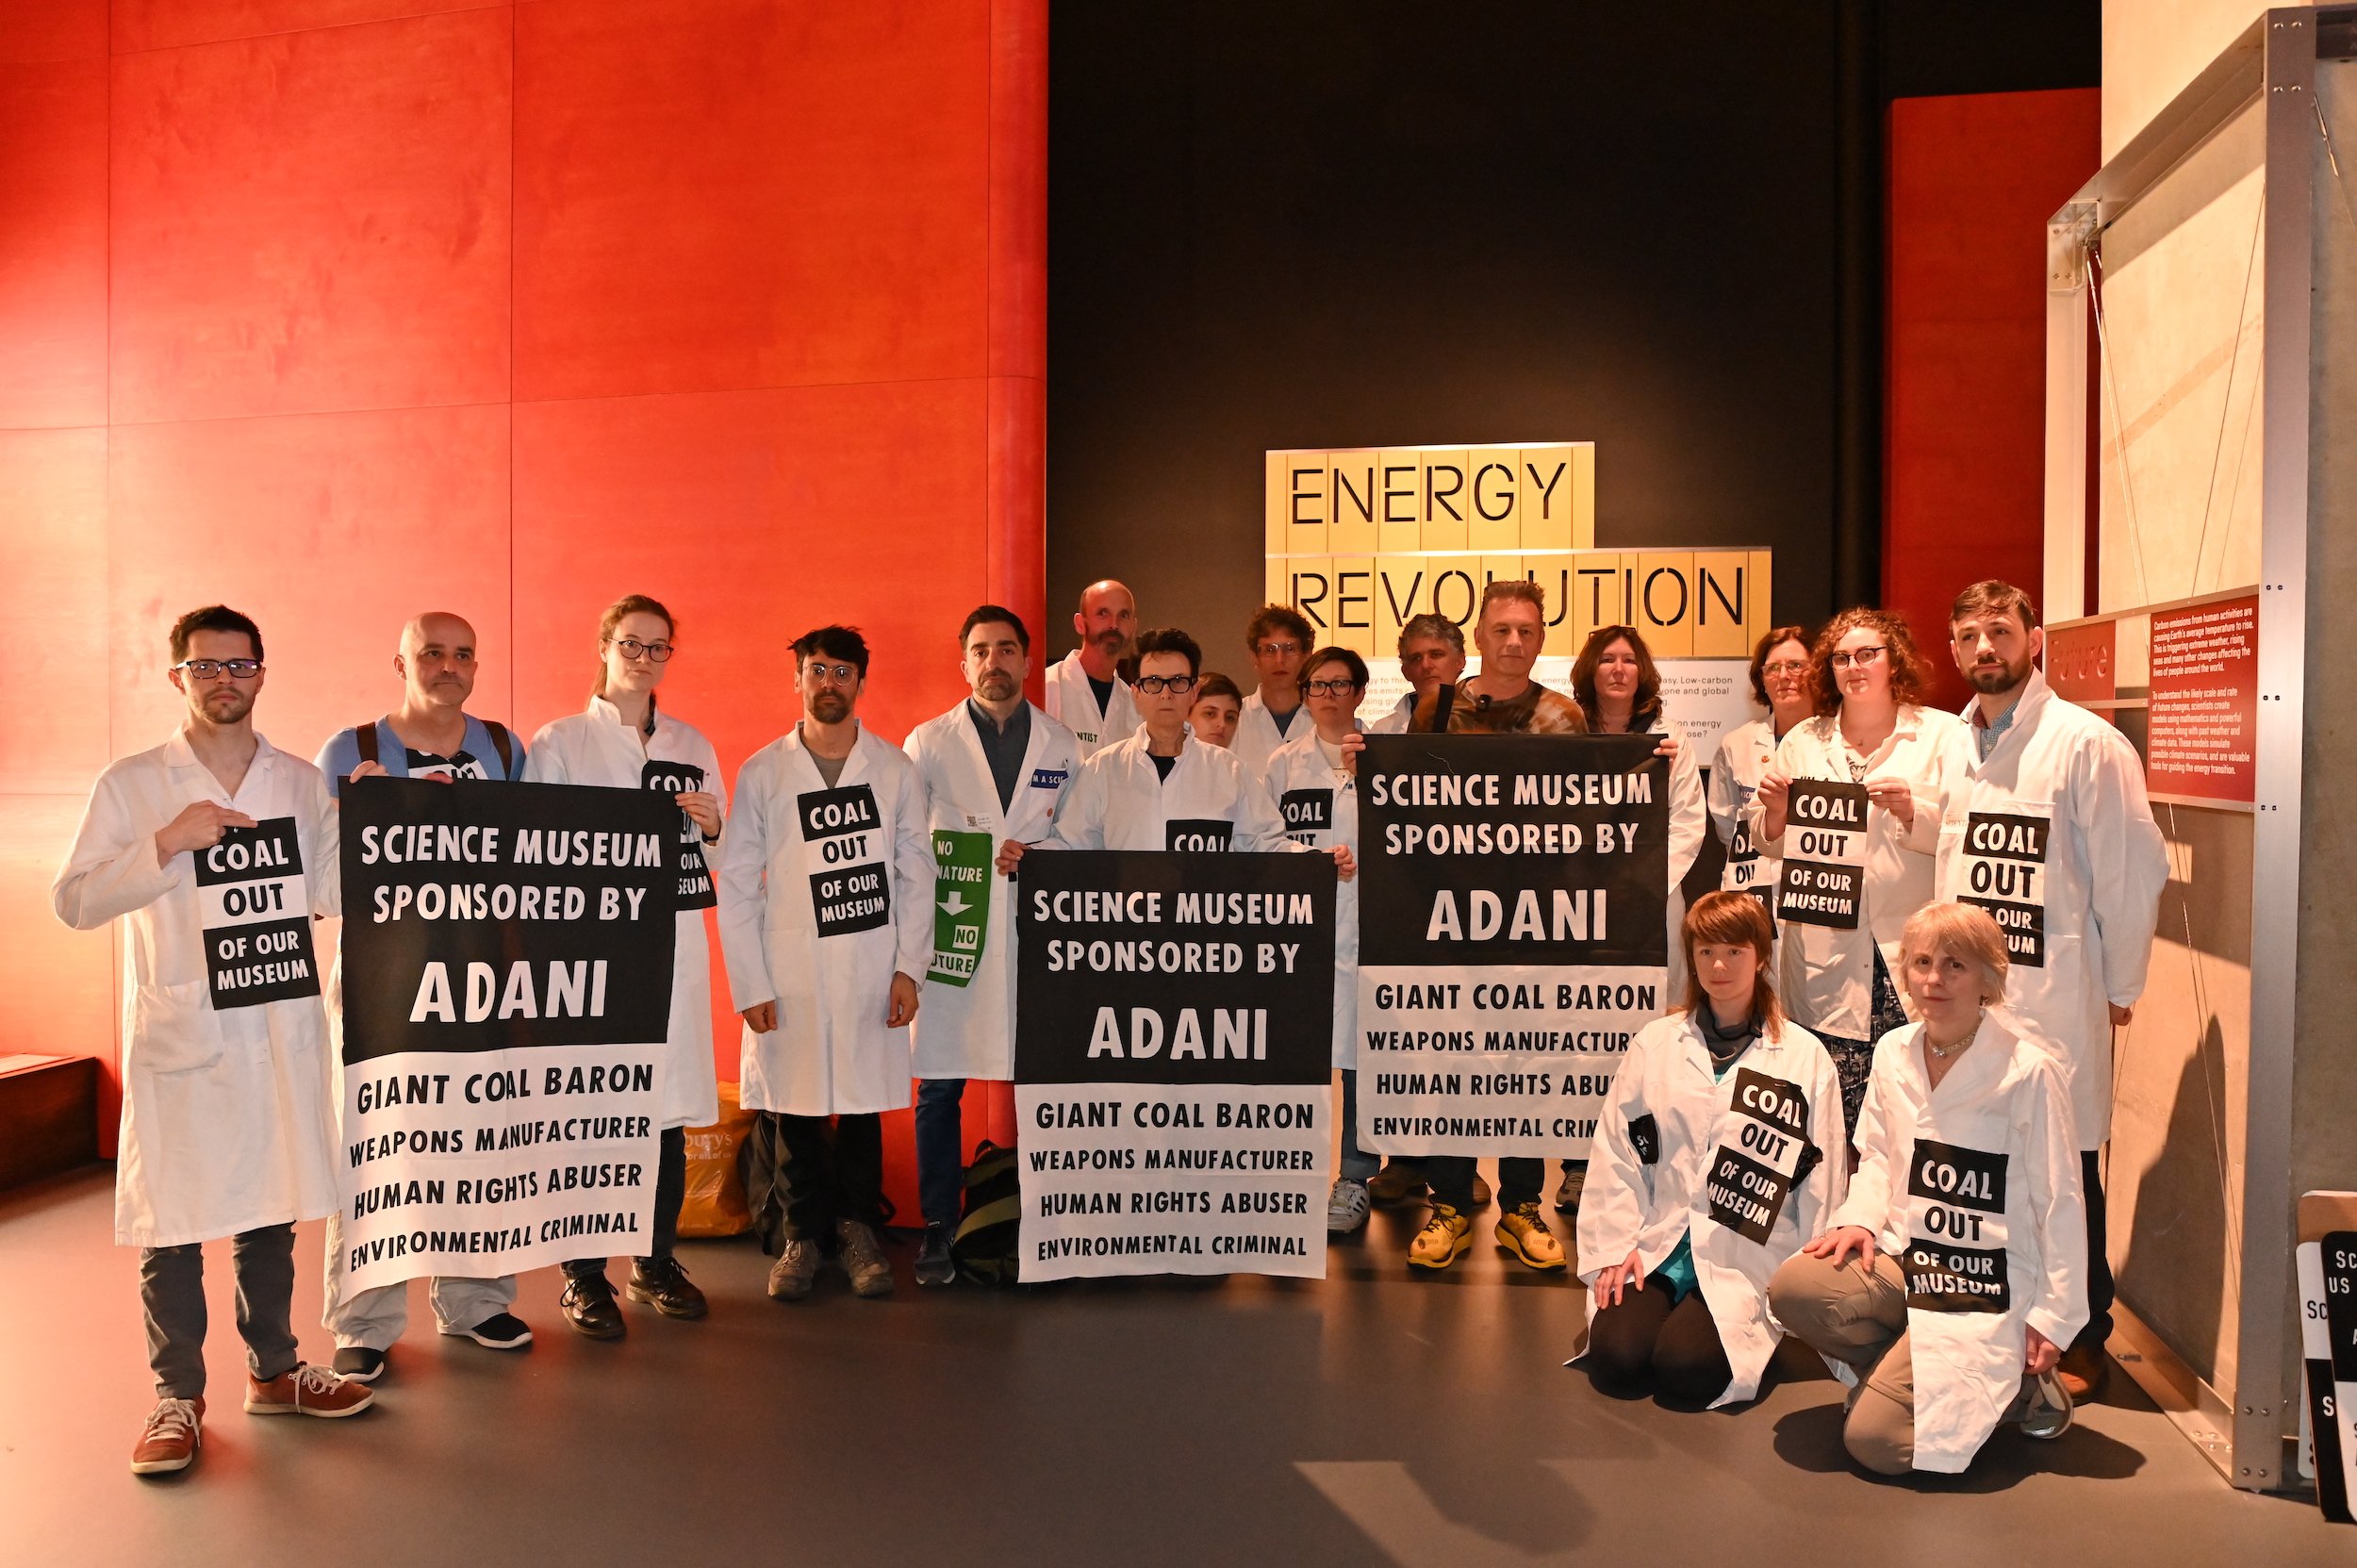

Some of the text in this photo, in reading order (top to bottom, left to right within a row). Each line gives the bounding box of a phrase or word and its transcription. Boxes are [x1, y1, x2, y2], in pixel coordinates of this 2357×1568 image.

[1292, 463, 1566, 524] ENERGY
[1292, 568, 1743, 628] REVOUTION
[2154, 608, 2252, 631] Carbon emissions from human activities are
[2154, 632, 2169, 643] causing
[2170, 630, 2185, 639] Earth's
[2186, 628, 2204, 638] average
[2205, 623, 2235, 636] temperature
[2242, 619, 2253, 629] rise.
[2167, 641, 2188, 652] triggering
[2189, 640, 2207, 650] extreme
[2209, 637, 2229, 647] weather,
[2230, 635, 2245, 645] rising
[2172, 655, 2184, 665] many
[2184, 652, 2197, 662] other
[2198, 651, 2217, 662] changes
[2218, 648, 2241, 659] affecting
[2242, 647, 2250, 655] the
[2153, 668, 2163, 677] lives
[2164, 667, 2168, 676] of
[2168, 666, 2184, 678] people
[2184, 665, 2200, 674] around
[2210, 662, 2224, 671] world.
[1702, 687, 1729, 696] global
[1076, 732, 1098, 743] NTIST
[650, 775, 704, 792] COA
[1373, 773, 1652, 805] SCIENCE MUSEUM
[810, 800, 870, 830] COAL
[1283, 801, 1324, 823] OAL
[1796, 795, 1857, 822] COAL
[362, 825, 661, 867] SCIENCE MUSEUM
[823, 835, 865, 864] OUT
[937, 840, 953, 856] NO
[1386, 823, 1639, 854] SPONSORED BY
[1801, 832, 1848, 856] OUT
[1973, 823, 2038, 854] COAL
[207, 838, 288, 872] COAL
[681, 852, 702, 870] OUR
[821, 874, 879, 898] OF OUR
[936, 866, 982, 883] NATURE
[1790, 869, 1851, 891] OF OUR
[1970, 862, 2035, 898] OUT
[223, 883, 283, 916] OUT
[373, 883, 647, 923] SPONSORED BY
[822, 897, 884, 922] MUSEUM
[1034, 890, 1312, 924] SCIENCE MUSEUM
[1783, 892, 1852, 915] MUSEUM
[1426, 889, 1607, 940] ADANI
[1996, 908, 2033, 929] OUR
[219, 931, 299, 960] OF OUR
[955, 929, 977, 946] NO
[1048, 940, 1299, 973] SPONSORED BY
[218, 959, 309, 990] MUSEUM
[409, 960, 607, 1022] ADANI
[1376, 984, 1655, 1010] GIANT COAL BARON
[1087, 1007, 1267, 1060] ADANI
[1367, 1032, 1636, 1051] WEAPONS MANUFACTUR
[358, 1065, 652, 1114] GIANT COAL BARON
[1377, 1074, 1615, 1096] HUMAN RIGHTS ABU
[1037, 1102, 1312, 1129] GIANT COAL BARON
[1743, 1084, 1801, 1128] COAL
[1374, 1117, 1542, 1136] ENVIRONMENTAL
[350, 1116, 650, 1168] WEAPONS MANUFACTURER
[1741, 1124, 1788, 1162] OUT
[1030, 1149, 1312, 1171] WEAPONS MANUFACTURER
[354, 1164, 641, 1220] HUMAN RIGHTS ABUSER
[1720, 1161, 1778, 1200] OF OUR
[1921, 1160, 1992, 1199] COAL
[1042, 1192, 1307, 1216] HUMAN RIGHTS ABUSER
[1707, 1182, 1771, 1227] MUSEUM
[1925, 1207, 1983, 1241] OUT
[351, 1213, 637, 1272] ENVIRONMENTAL CRIMINAL
[1039, 1235, 1306, 1261] ENVIRONMENTAL CRIMINAL
[1914, 1251, 1993, 1275] OF OUR
[1913, 1273, 2001, 1295] MUSEUM
[2329, 1277, 2350, 1294] US
